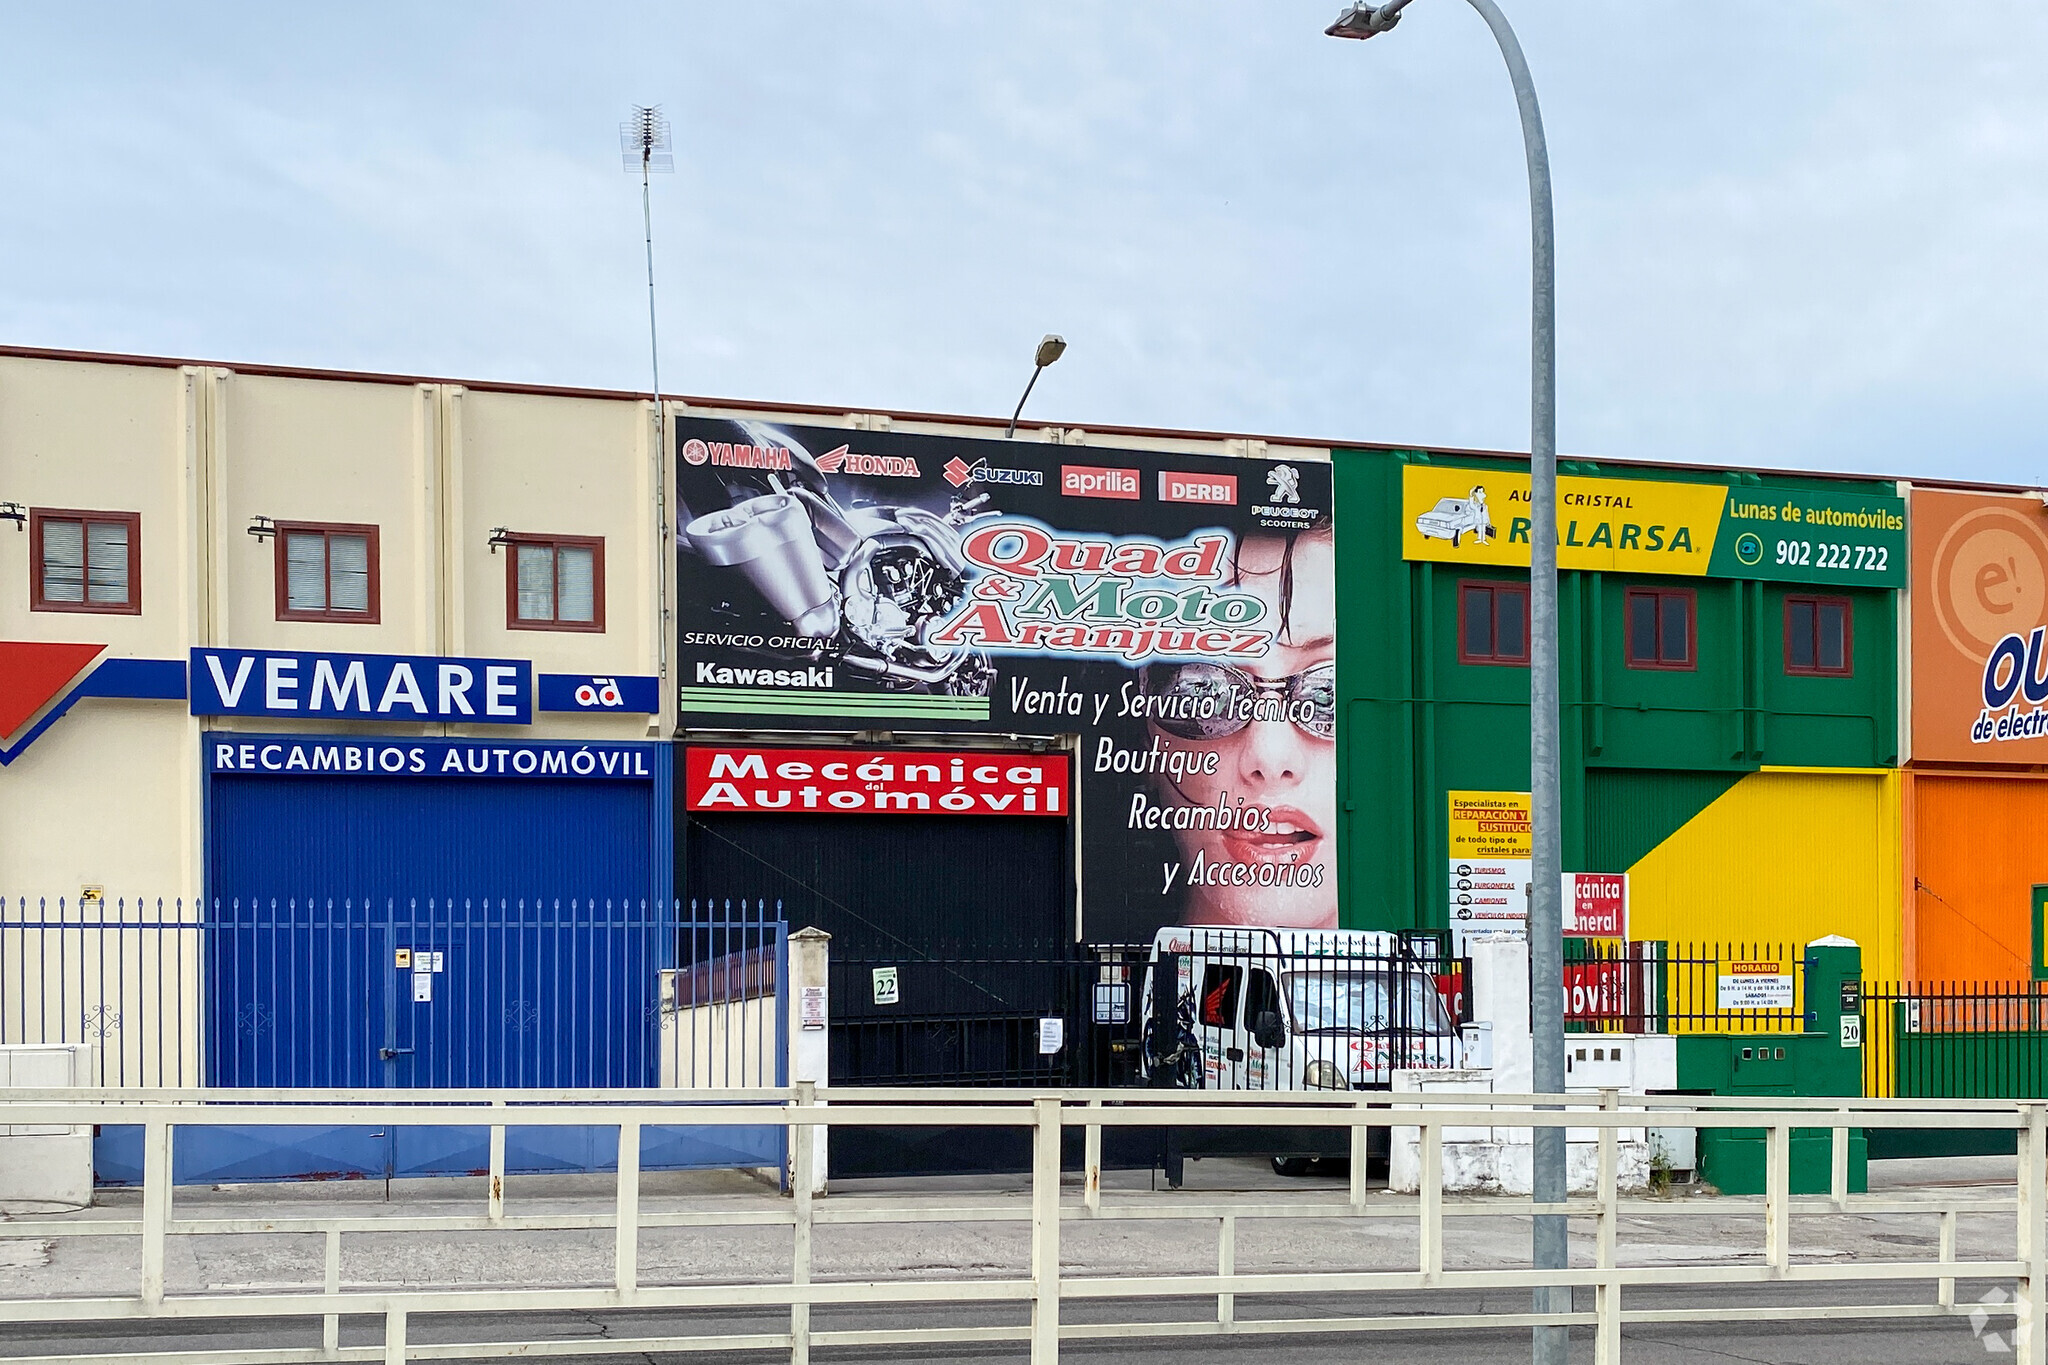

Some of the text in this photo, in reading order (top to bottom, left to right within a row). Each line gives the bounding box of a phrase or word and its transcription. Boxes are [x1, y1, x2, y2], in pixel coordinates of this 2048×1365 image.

[708, 442, 792, 470] YAMAHA
[844, 454, 920, 477] HONDA
[972, 467, 1043, 486] SUZUKI
[1065, 471, 1136, 494] aprilia
[1171, 482, 1230, 501] DERBI
[1564, 493, 1633, 508] CRISTAL
[1252, 505, 1318, 519] PEUGEOT
[1730, 498, 1903, 530] Lunas de automóviles
[1260, 519, 1310, 529] SCOOTERS
[1508, 517, 1693, 553] RLARSA
[961, 524, 1228, 580] Quad
[1776, 539, 1888, 571] 902 222 722
[973, 574, 1266, 626] & Moto
[684, 632, 840, 650] SERVICIO OFICIAL:
[930, 600, 1274, 660] Aranjuez
[205, 655, 517, 716] VEMARE
[696, 662, 833, 688] Kawasaki
[1011, 676, 1315, 726] Venta y Servicio Técnico
[1972, 705, 2048, 741] de electr
[216, 744, 648, 776] RECAMBIOS AUTOMÓVIL
[708, 753, 1042, 784] Mecánica
[1094, 736, 1219, 783] Boutique
[697, 782, 1059, 812] Automóvil
[865, 782, 884, 792] del
[1128, 792, 1271, 831] Recambios
[1454, 799, 1506, 808] Especialistas
[1454, 810, 1527, 820] REPARACIÓN Y
[1480, 822, 1532, 832] SUSTITUCI
[1456, 835, 1466, 843] de
[1489, 836, 1505, 845] tipo
[1507, 836, 1517, 844] de
[1162, 849, 1324, 895] y Accesorios
[1576, 877, 1619, 899] cánica
[1574, 908, 1617, 931] eneral
[1734, 964, 1778, 972] HORARIO
[877, 979, 895, 996] 22
[1843, 1025, 1858, 1040] 20
